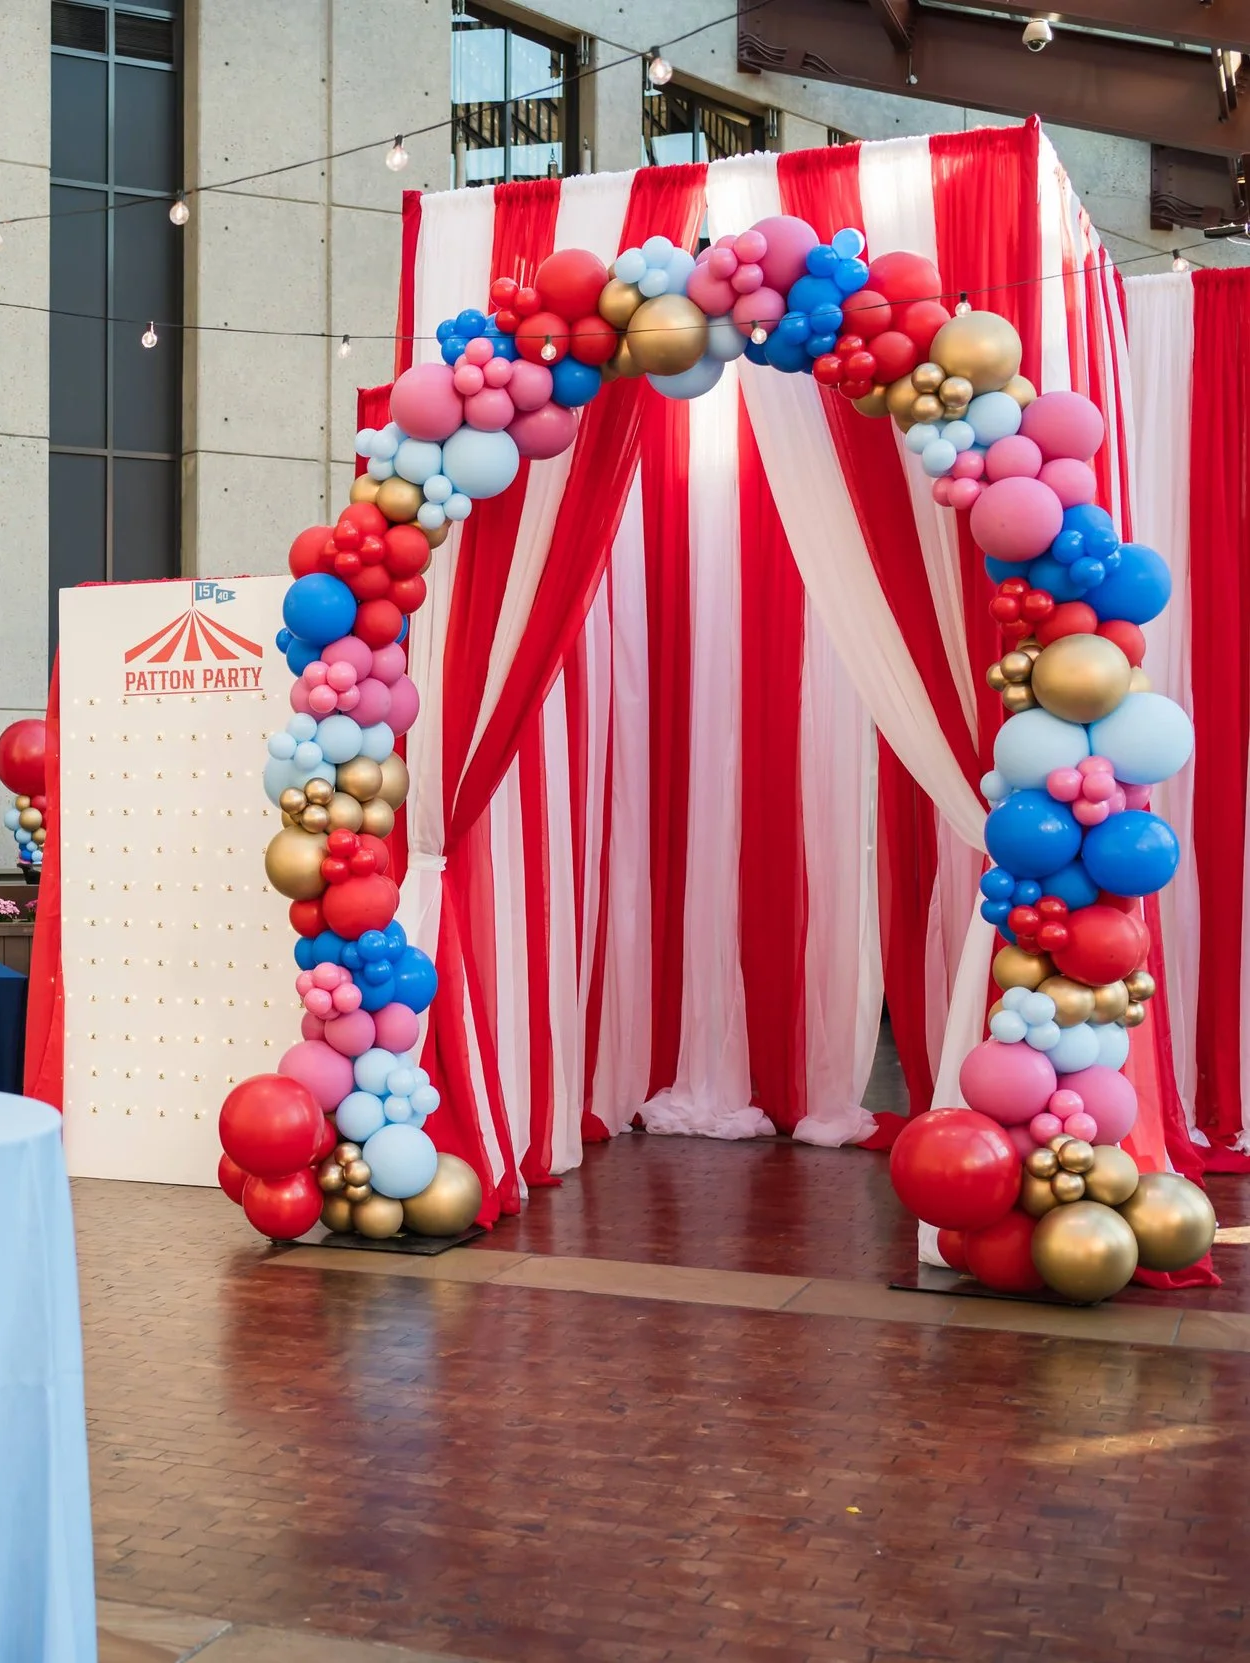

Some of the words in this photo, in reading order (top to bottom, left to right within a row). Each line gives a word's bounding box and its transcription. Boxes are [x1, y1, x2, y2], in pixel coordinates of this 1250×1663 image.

[199, 585, 211, 597] 15
[217, 591, 229, 601] 40
[125, 669, 195, 692] PATTON
[203, 666, 262, 689] PARTY
